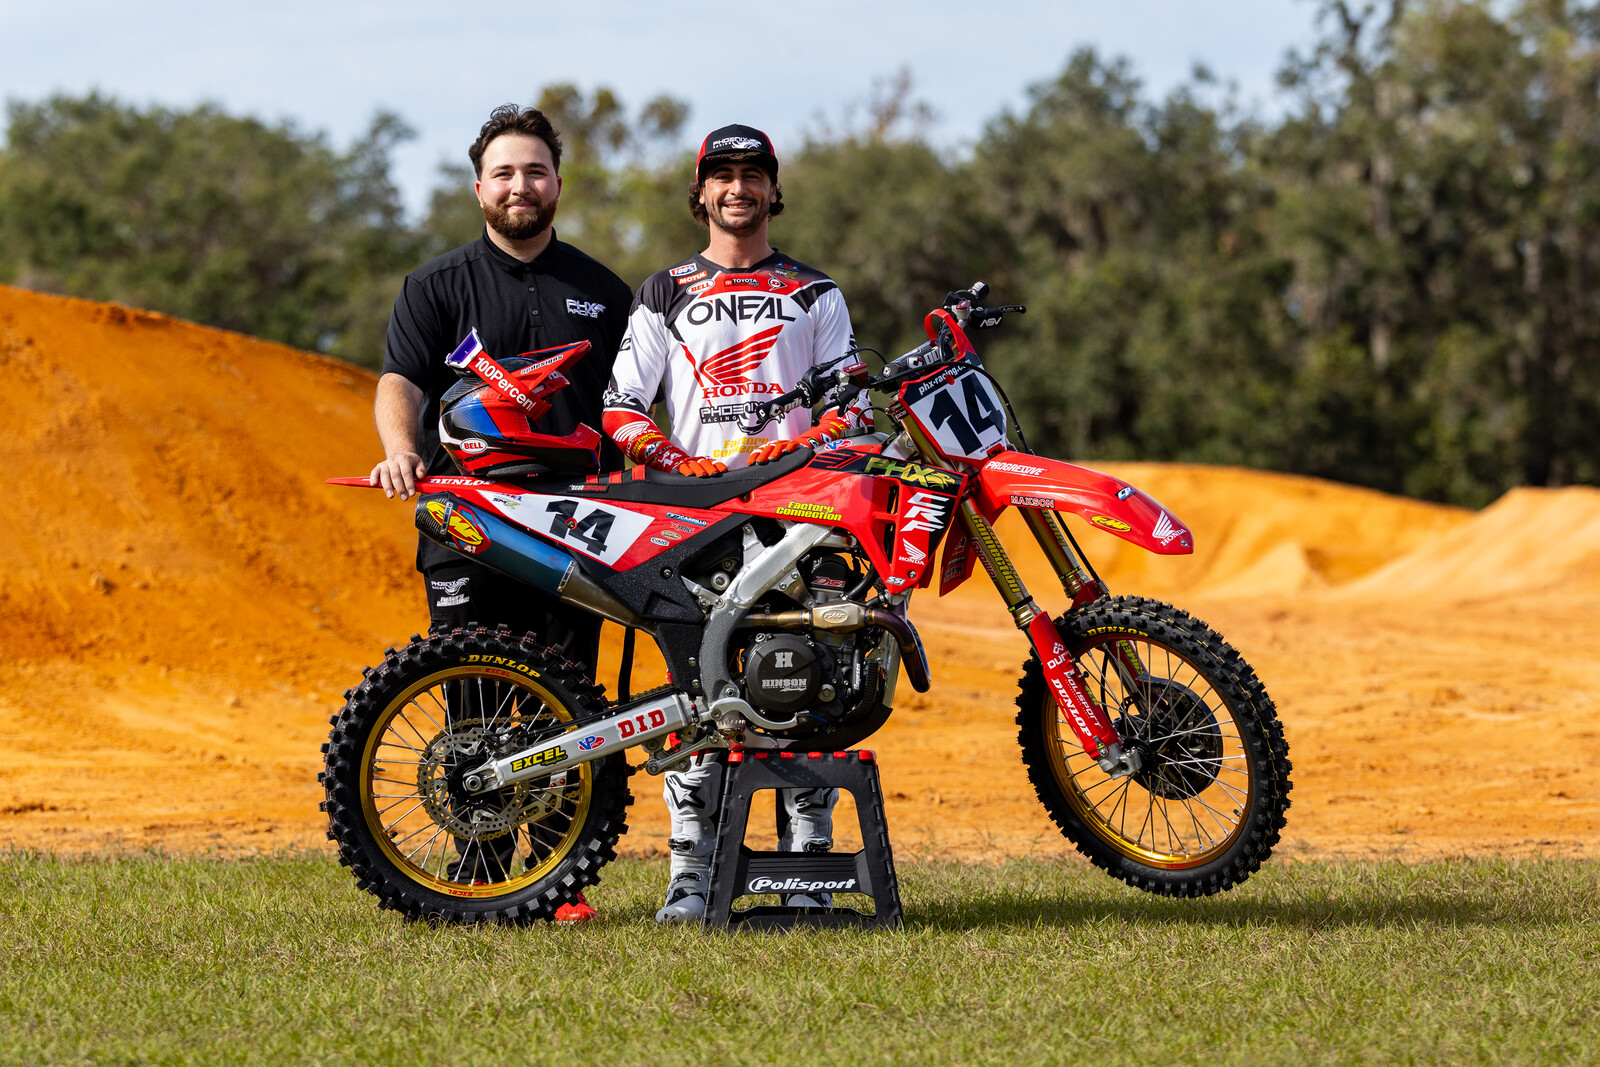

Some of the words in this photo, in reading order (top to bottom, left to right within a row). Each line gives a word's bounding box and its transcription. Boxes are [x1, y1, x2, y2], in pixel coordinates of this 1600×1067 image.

[679, 272, 706, 285] MOTUL
[691, 282, 711, 293] BELL
[980, 317, 1002, 328] ASV
[702, 383, 786, 399] HONDA
[929, 372, 1005, 456] 14
[463, 442, 484, 450] BELL
[985, 461, 1045, 476] PROGRESSIVE
[430, 478, 497, 486] DUNLOP
[788, 501, 835, 512] Factory
[1011, 495, 1055, 509] MAKSON
[776, 506, 842, 522] Connection
[900, 492, 949, 533] CRF
[545, 499, 616, 556] 14
[1160, 528, 1187, 547] HONDA
[898, 556, 925, 566] HONDA
[970, 514, 1020, 593] Connection
[1087, 626, 1149, 637] DUNLOP
[466, 654, 541, 678] DUNLOP
[775, 652, 793, 668] H
[762, 679, 807, 687] HINSON
[1051, 678, 1092, 737] DUNLOP
[618, 709, 666, 739] D.I.D
[512, 747, 566, 773] EXCEL
[753, 877, 856, 892] Polisport
